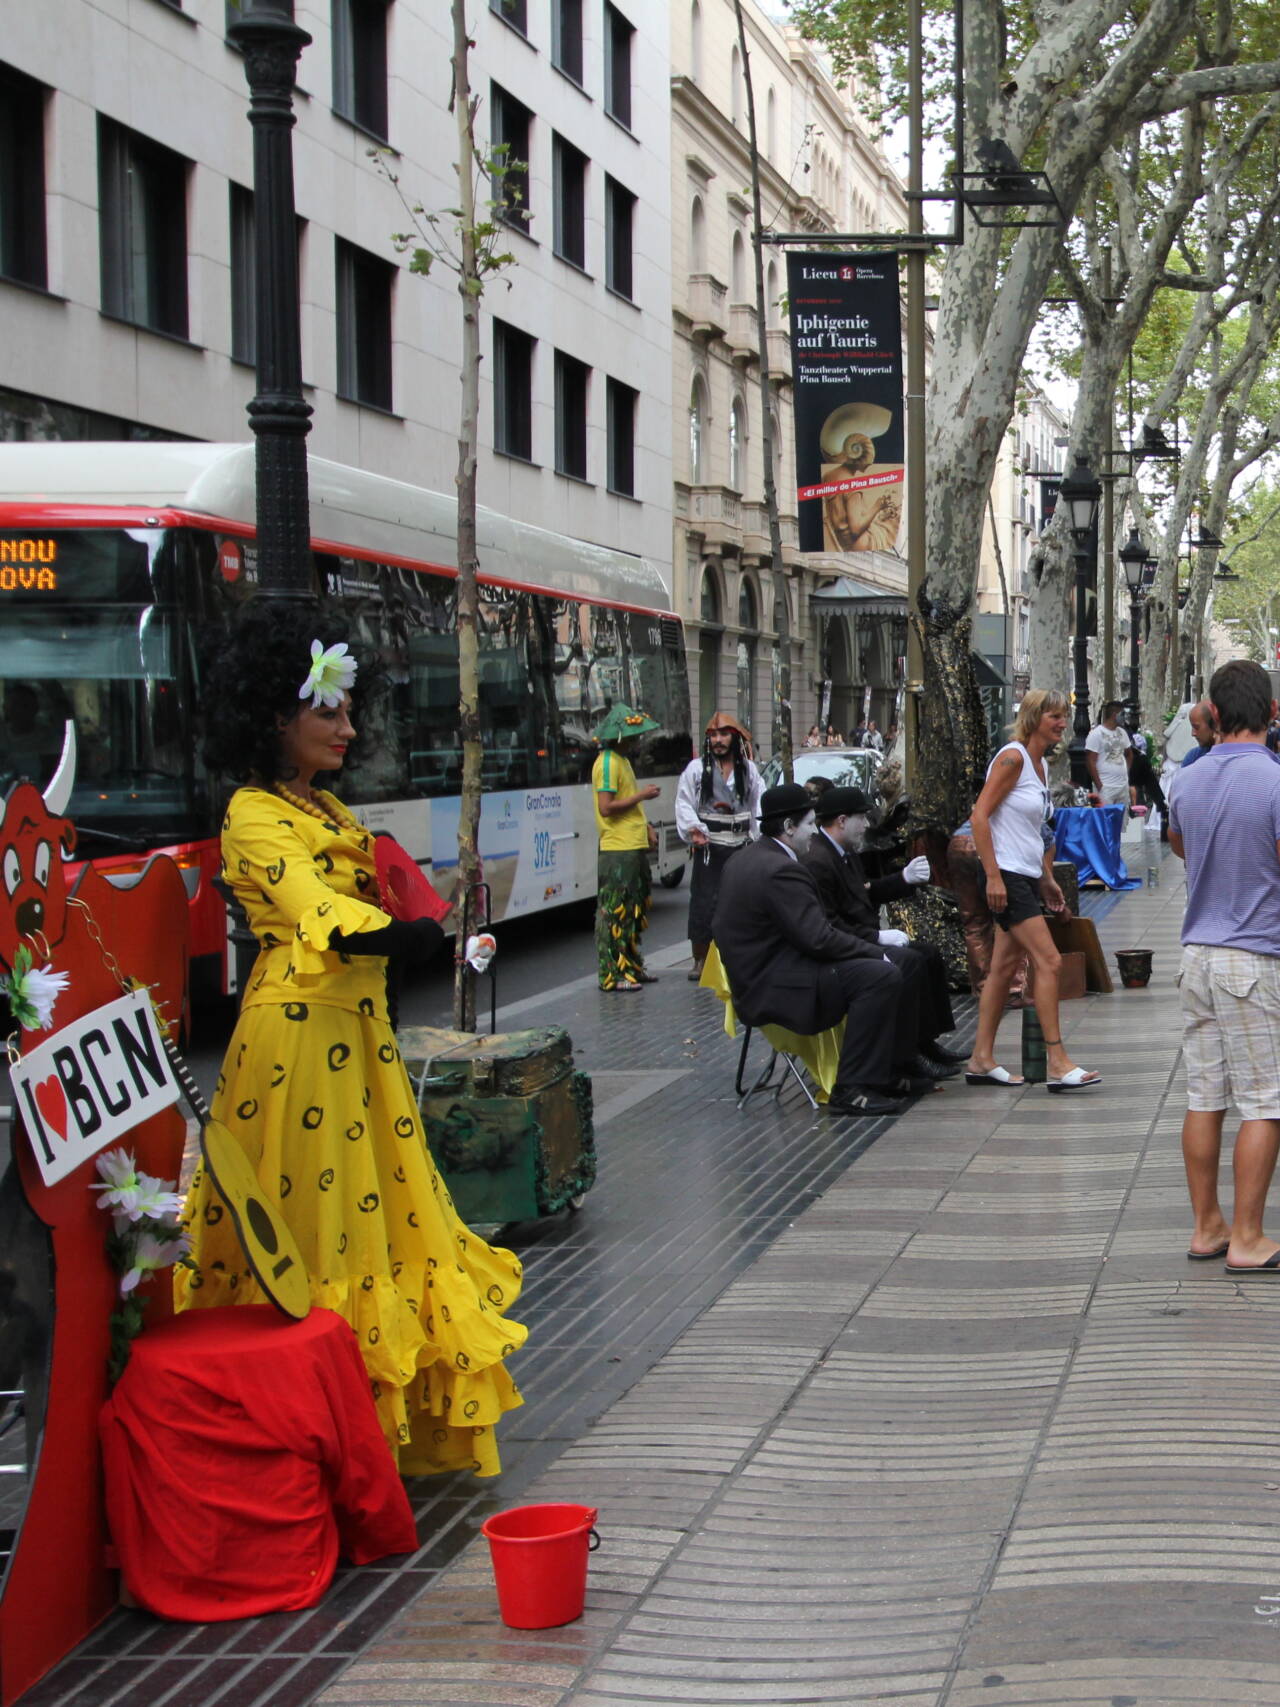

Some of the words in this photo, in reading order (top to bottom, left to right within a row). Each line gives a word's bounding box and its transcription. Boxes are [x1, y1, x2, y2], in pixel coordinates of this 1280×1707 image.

[802, 267, 838, 279] Liceu
[797, 314, 869, 333] Iphigenie
[797, 333, 824, 348] auf
[827, 332, 877, 348] Tauris
[799, 365, 848, 374] Tanztheater
[850, 365, 892, 376] Wuppertal
[800, 375, 819, 384] Pina
[822, 375, 851, 384] Bausch
[850, 480, 867, 489] Pina
[0, 539, 55, 562] NOU
[21, 1077, 57, 1165] I
[52, 1007, 168, 1139] BCN
